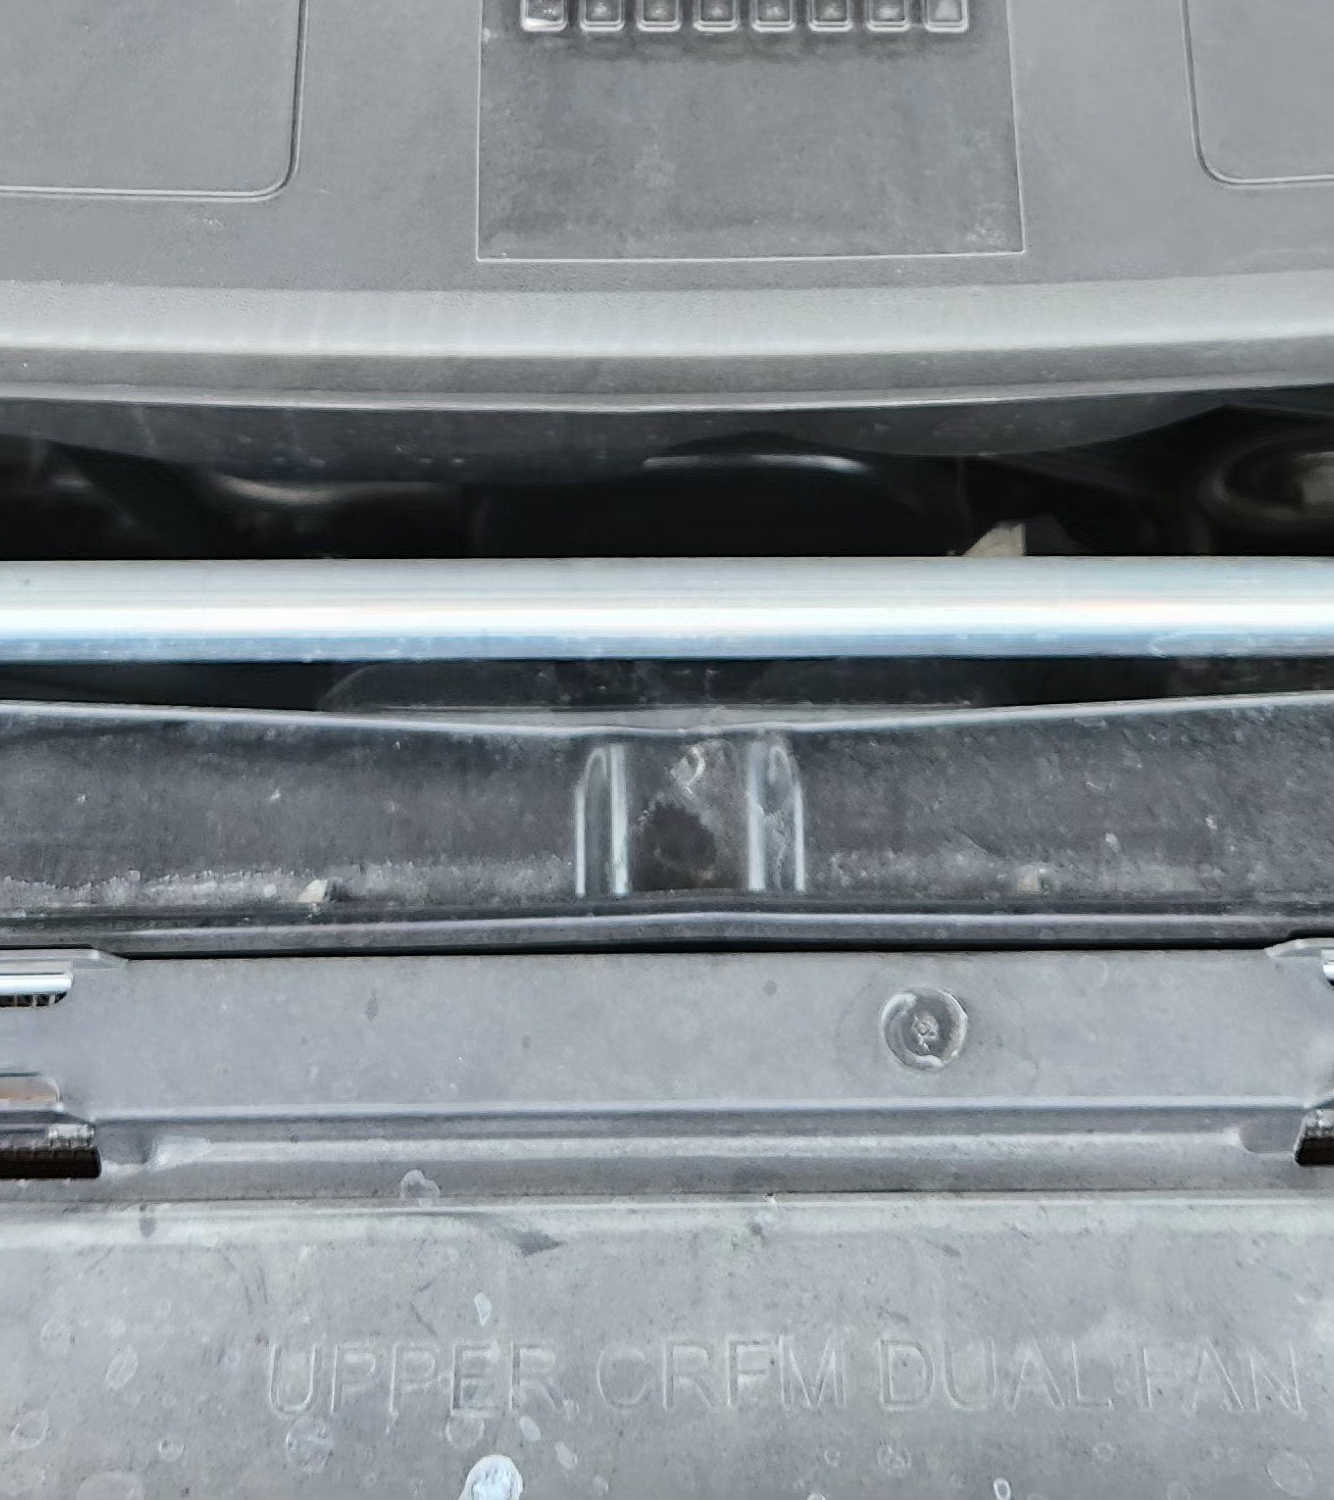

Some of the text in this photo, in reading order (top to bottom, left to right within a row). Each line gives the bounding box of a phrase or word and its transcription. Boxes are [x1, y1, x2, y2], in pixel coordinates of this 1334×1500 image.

[265, 1335, 1308, 1421] UPPER CRFM DUAL FAN
